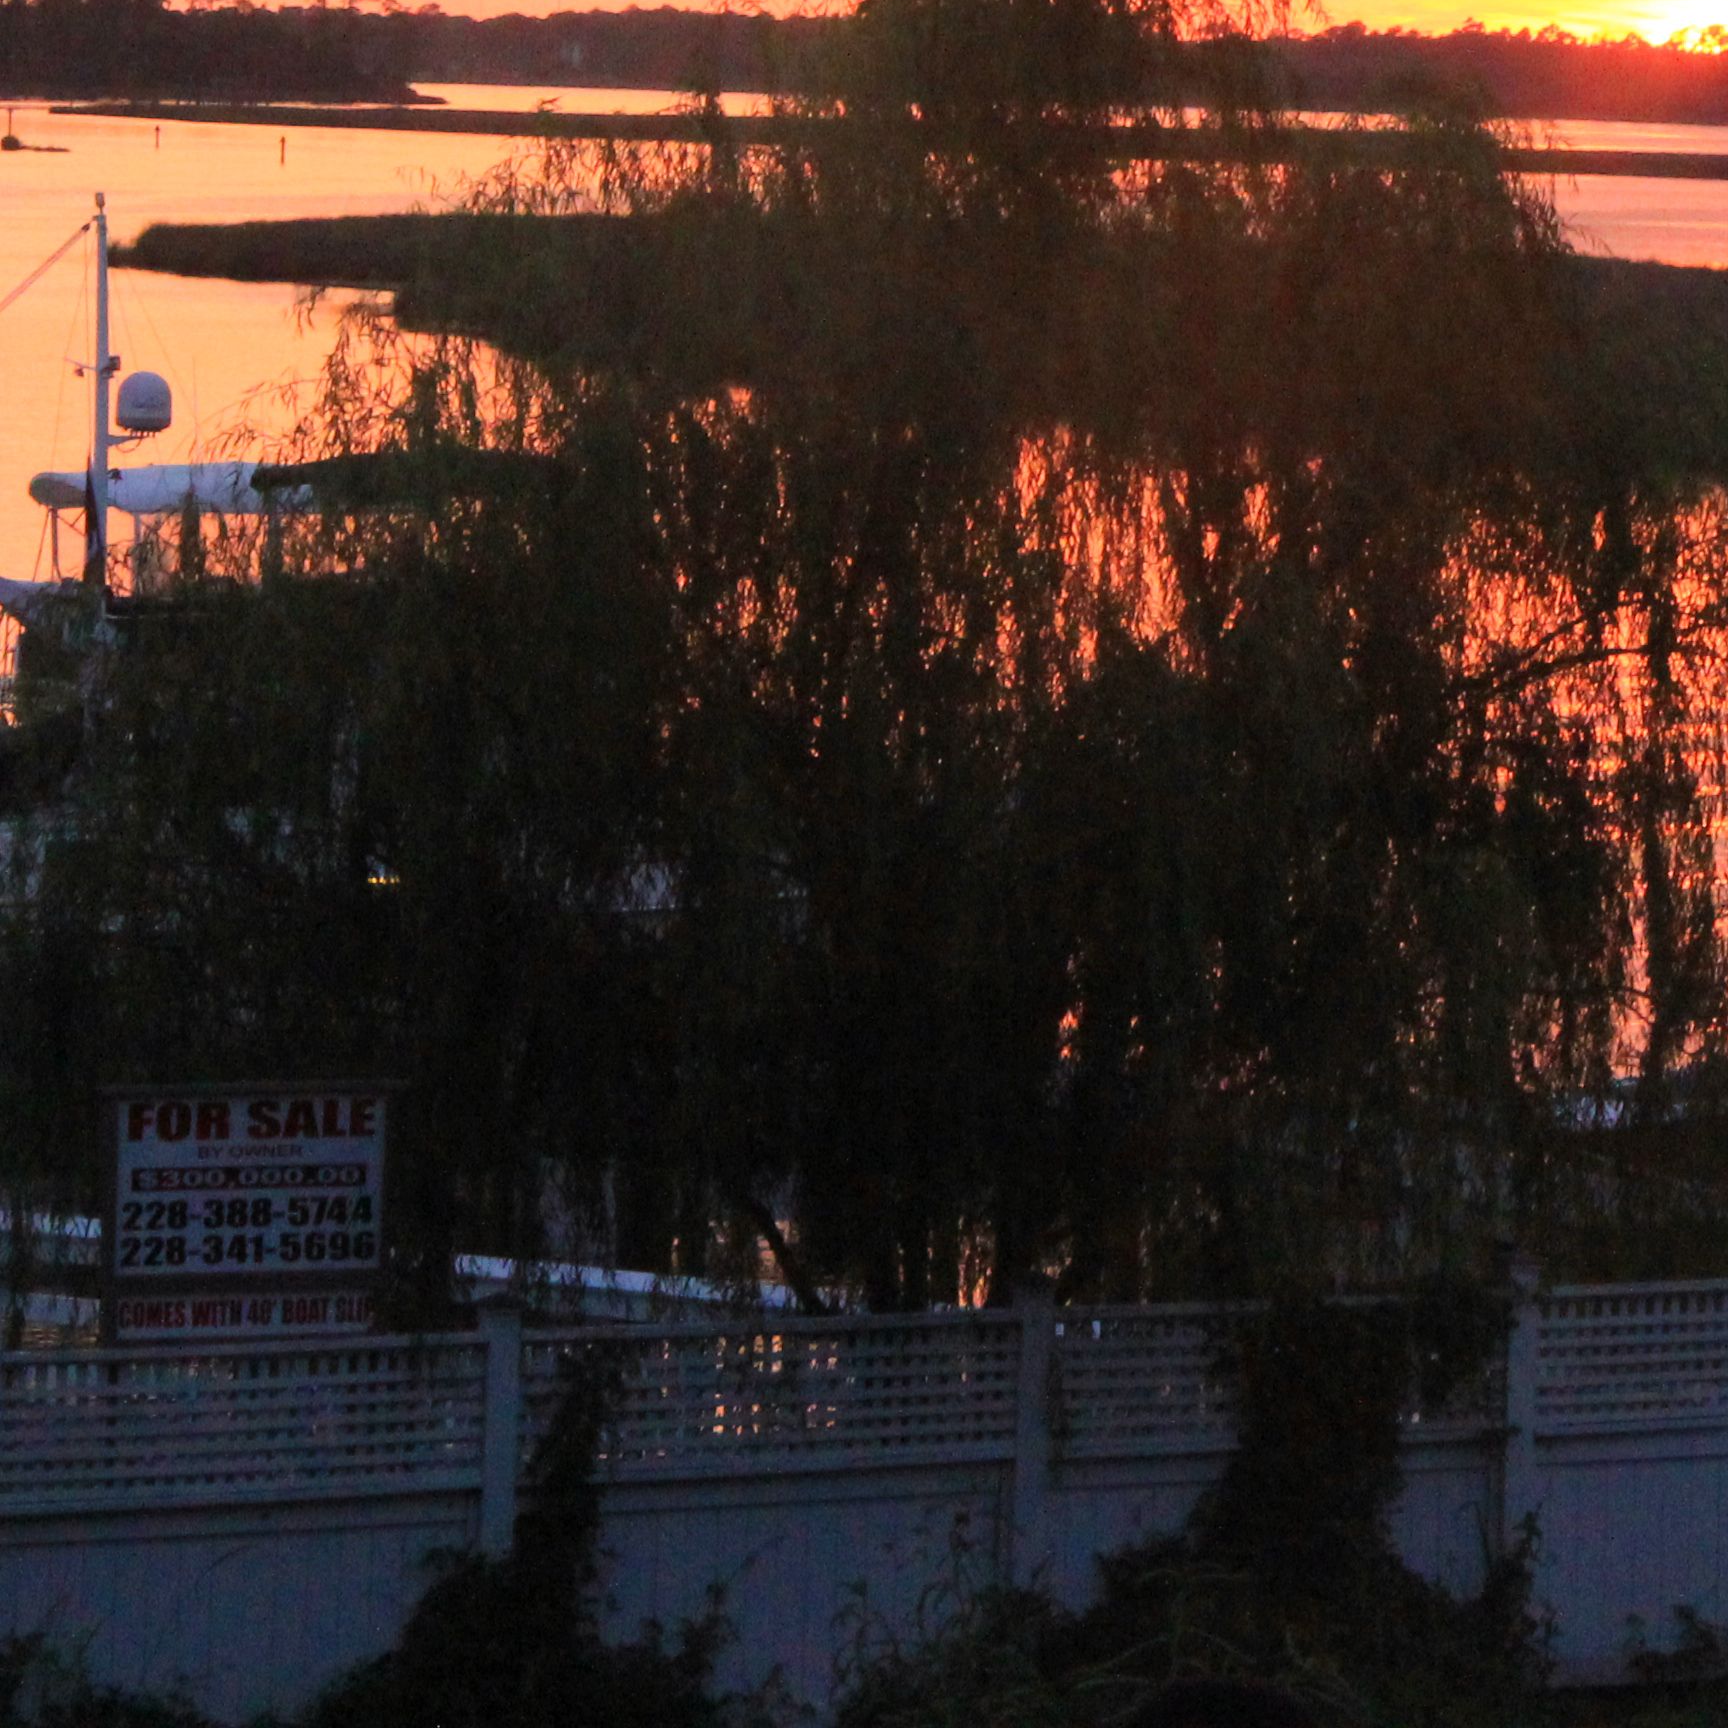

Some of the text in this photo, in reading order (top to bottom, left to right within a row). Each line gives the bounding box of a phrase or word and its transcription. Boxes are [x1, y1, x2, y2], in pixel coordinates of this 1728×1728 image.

[128, 1099, 376, 1142] FOR SALE
[197, 1144, 304, 1159] BY OWNER
[136, 1166, 361, 1189] $300,000.00
[122, 1196, 373, 1231] 228-388-5744
[120, 1231, 376, 1267] 228-341-5696
[119, 1299, 186, 1328] COMES
[191, 1298, 242, 1327] WITH
[283, 1297, 329, 1324] BOAT
